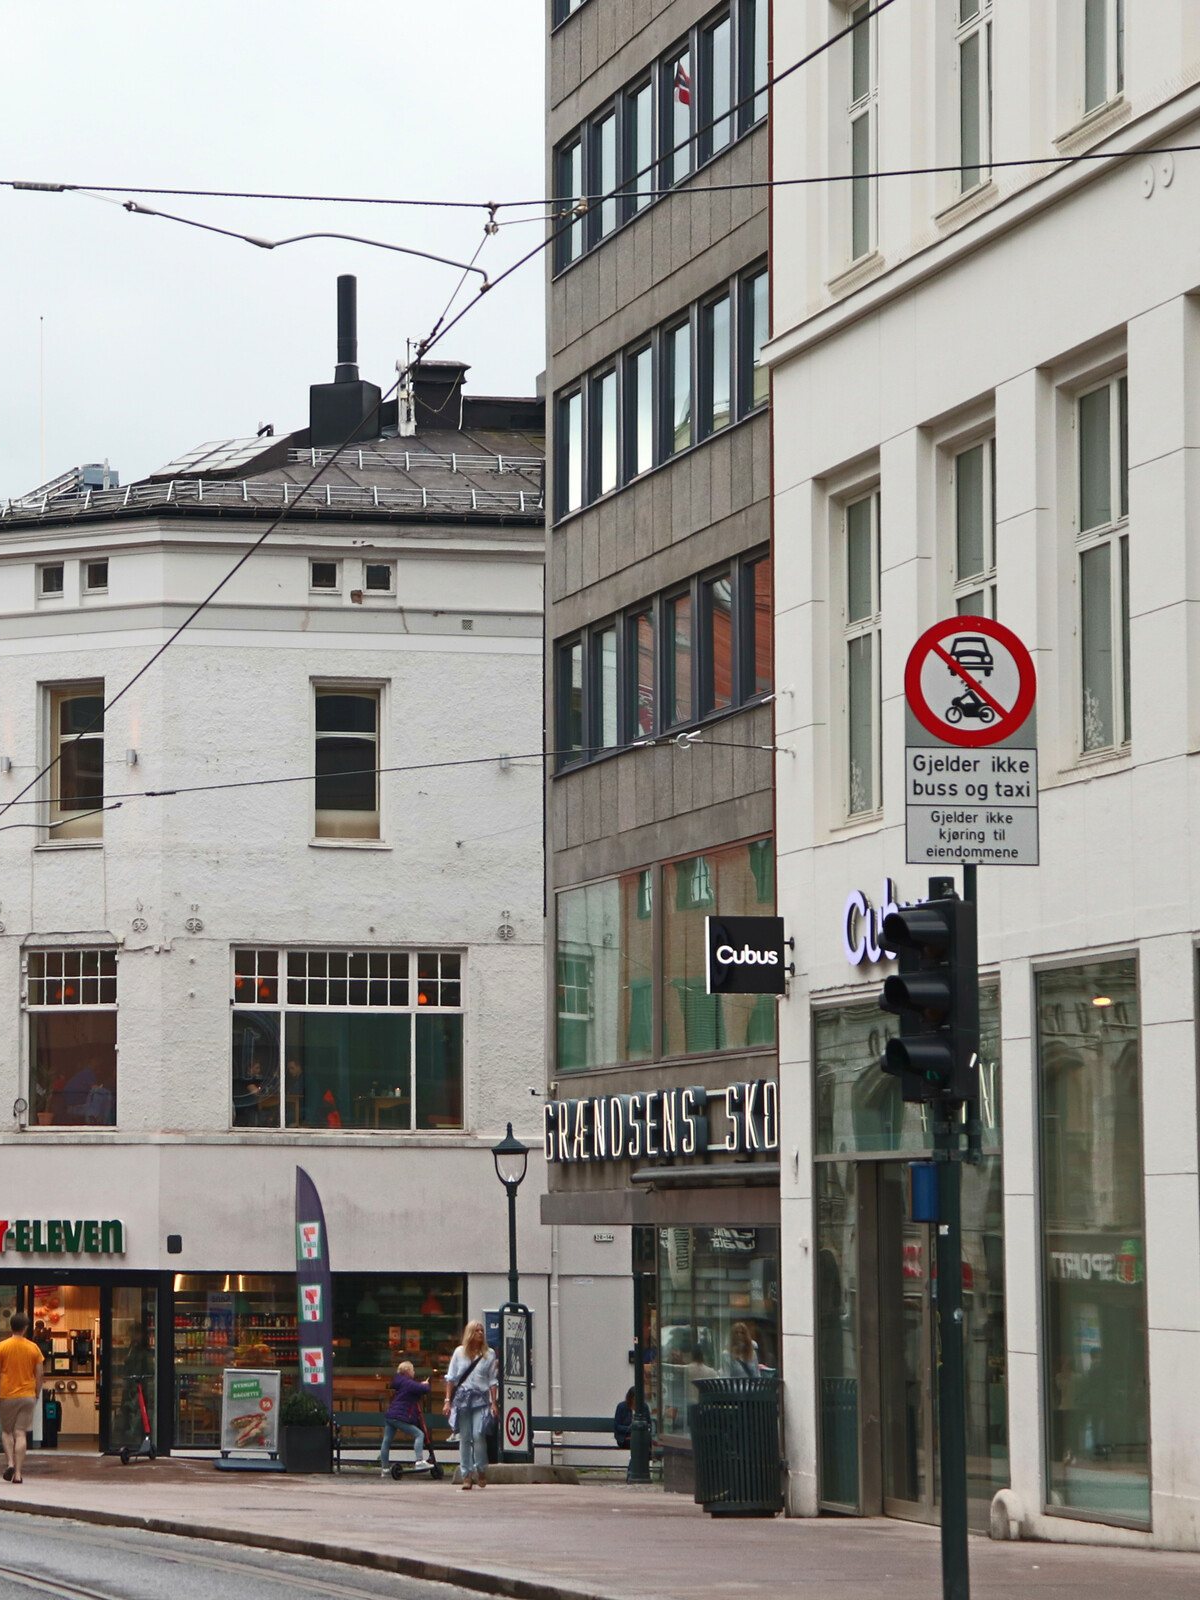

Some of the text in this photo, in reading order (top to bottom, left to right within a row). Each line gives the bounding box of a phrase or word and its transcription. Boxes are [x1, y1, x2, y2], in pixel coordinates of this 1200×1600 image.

[913, 754, 1030, 776] Gjelder ikke
[913, 779, 1031, 801] buss og taxi
[931, 810, 1013, 826] Gjelder ikke
[939, 828, 1006, 843] kjøring til
[926, 845, 1019, 858] eiendommene
[843, 877, 929, 966] Cub
[716, 943, 779, 965] Cubus
[543, 1088, 696, 1160] GRÆNDSENS
[507, 1387, 524, 1401] Sone
[509, 1417, 522, 1436] 30
